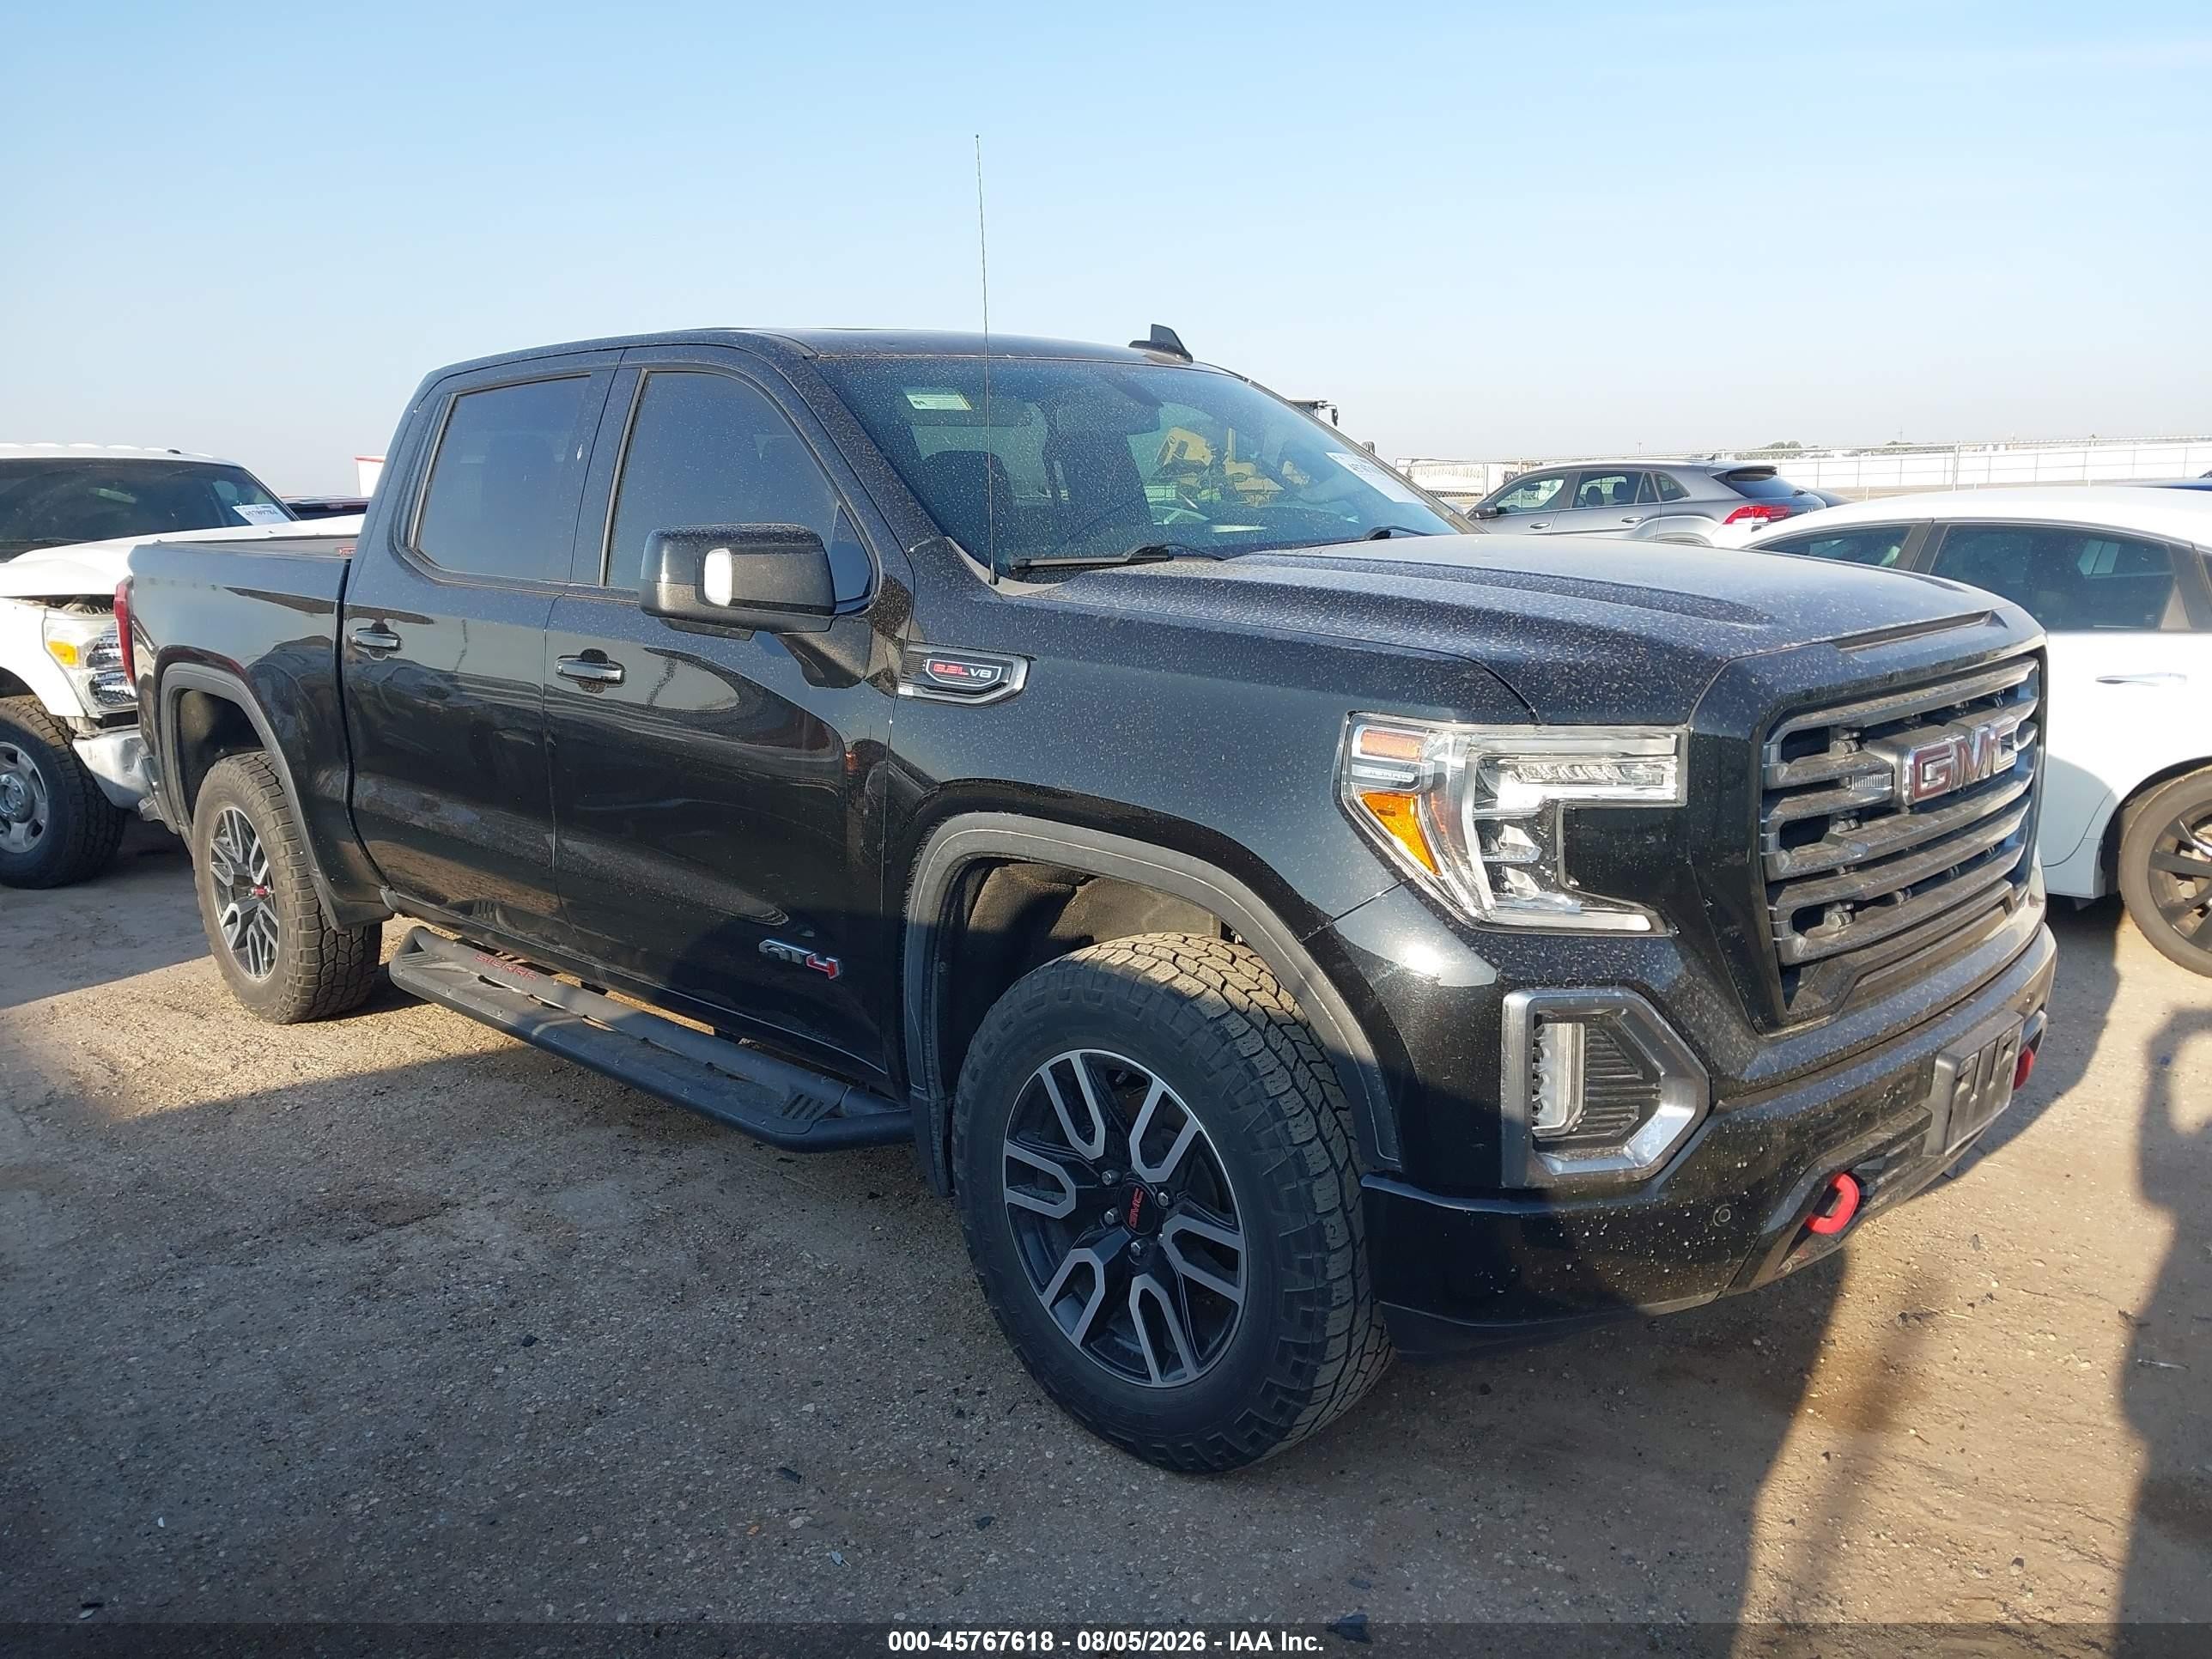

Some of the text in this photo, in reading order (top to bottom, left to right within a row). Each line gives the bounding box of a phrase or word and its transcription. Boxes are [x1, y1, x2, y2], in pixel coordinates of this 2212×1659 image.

[969, 667, 993, 678] V8
[1903, 714, 2019, 805] GMC
[474, 953, 538, 981] SIERRA
[758, 939, 840, 980] AT4
[1128, 1187, 1145, 1229] GMC
